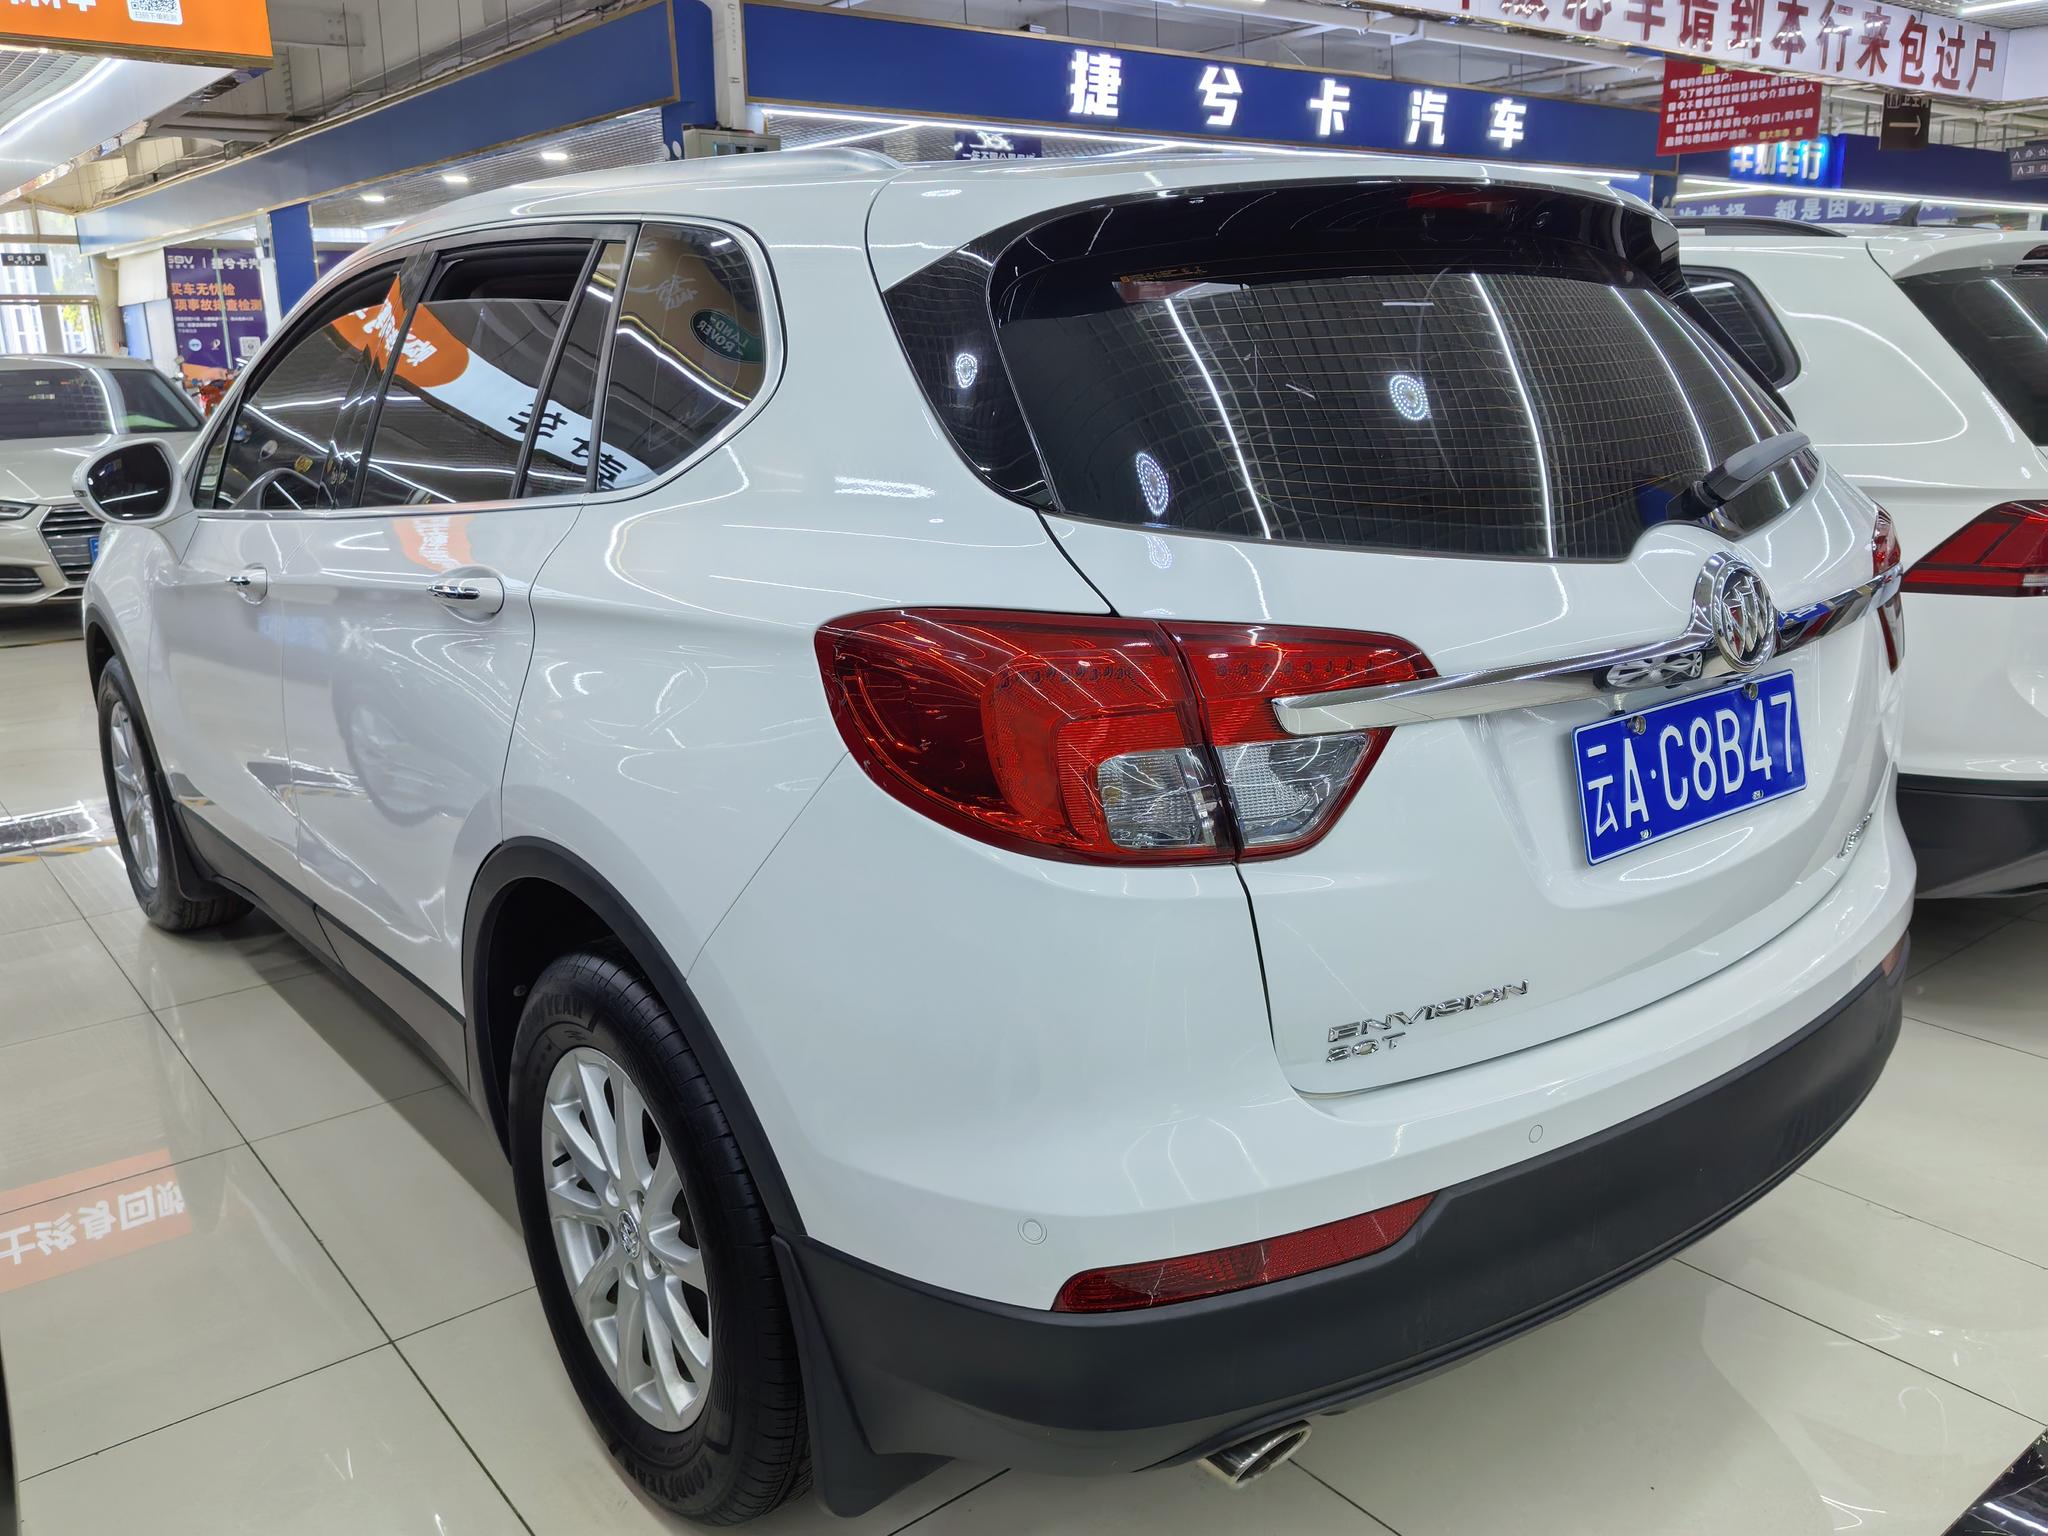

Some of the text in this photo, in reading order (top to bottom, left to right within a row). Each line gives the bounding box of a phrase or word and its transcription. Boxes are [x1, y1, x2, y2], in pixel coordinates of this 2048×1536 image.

[1460, 0, 1999, 93] 心车请到本行来包过户
[1069, 49, 1527, 149] 捷兮卡汽车
[1774, 198, 1948, 220] 都是因为喜
[1327, 979, 1529, 1042] ENVISION
[1326, 1032, 1406, 1063] 20T
